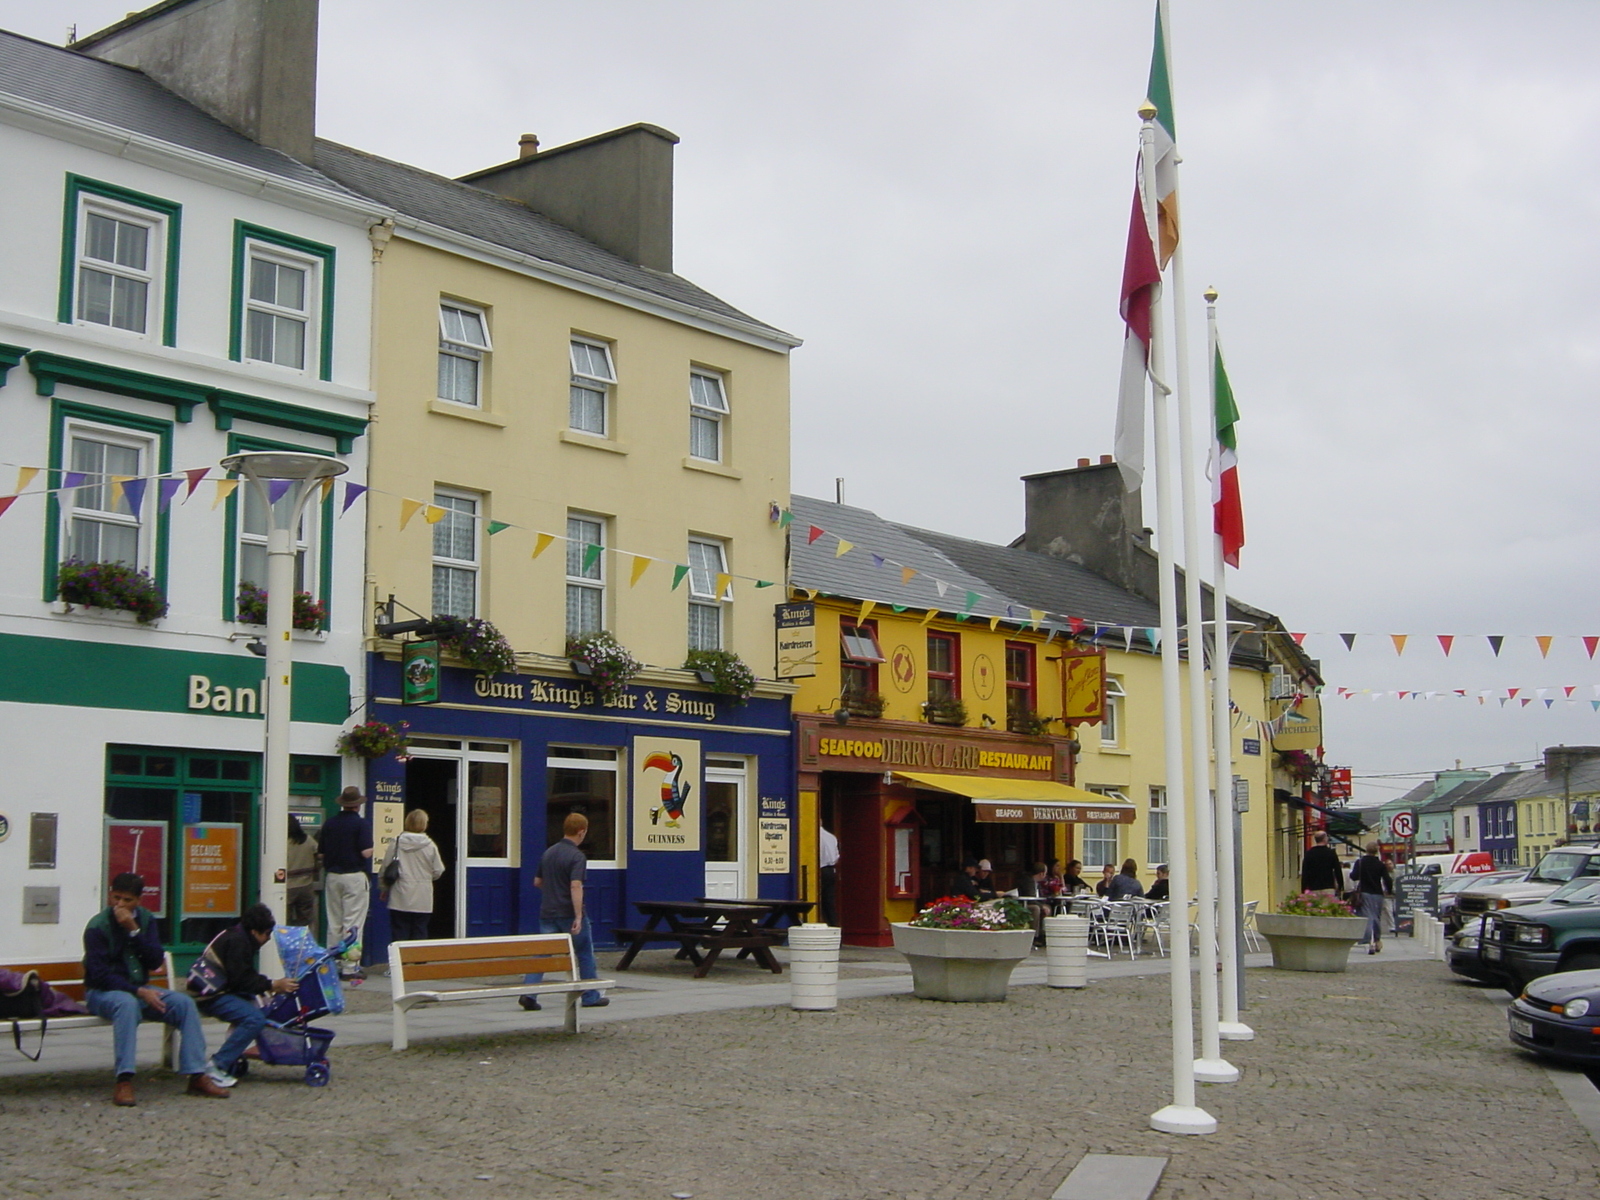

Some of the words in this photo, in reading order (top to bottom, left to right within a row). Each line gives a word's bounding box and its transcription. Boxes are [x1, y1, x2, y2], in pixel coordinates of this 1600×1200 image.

[529, 678, 596, 710] King's
[642, 690, 659, 712] &
[665, 692, 717, 721] Snug
[819, 738, 882, 759] SEAFOOD
[880, 737, 980, 770] DERRYCLARE
[978, 751, 1053, 772] RESTAURANT
[995, 808, 1024, 819] SEAFOOD
[1033, 807, 1078, 821] DERRYCLARE
[1086, 811, 1120, 820] RESTAURANT
[647, 834, 686, 844] GUINNESS
